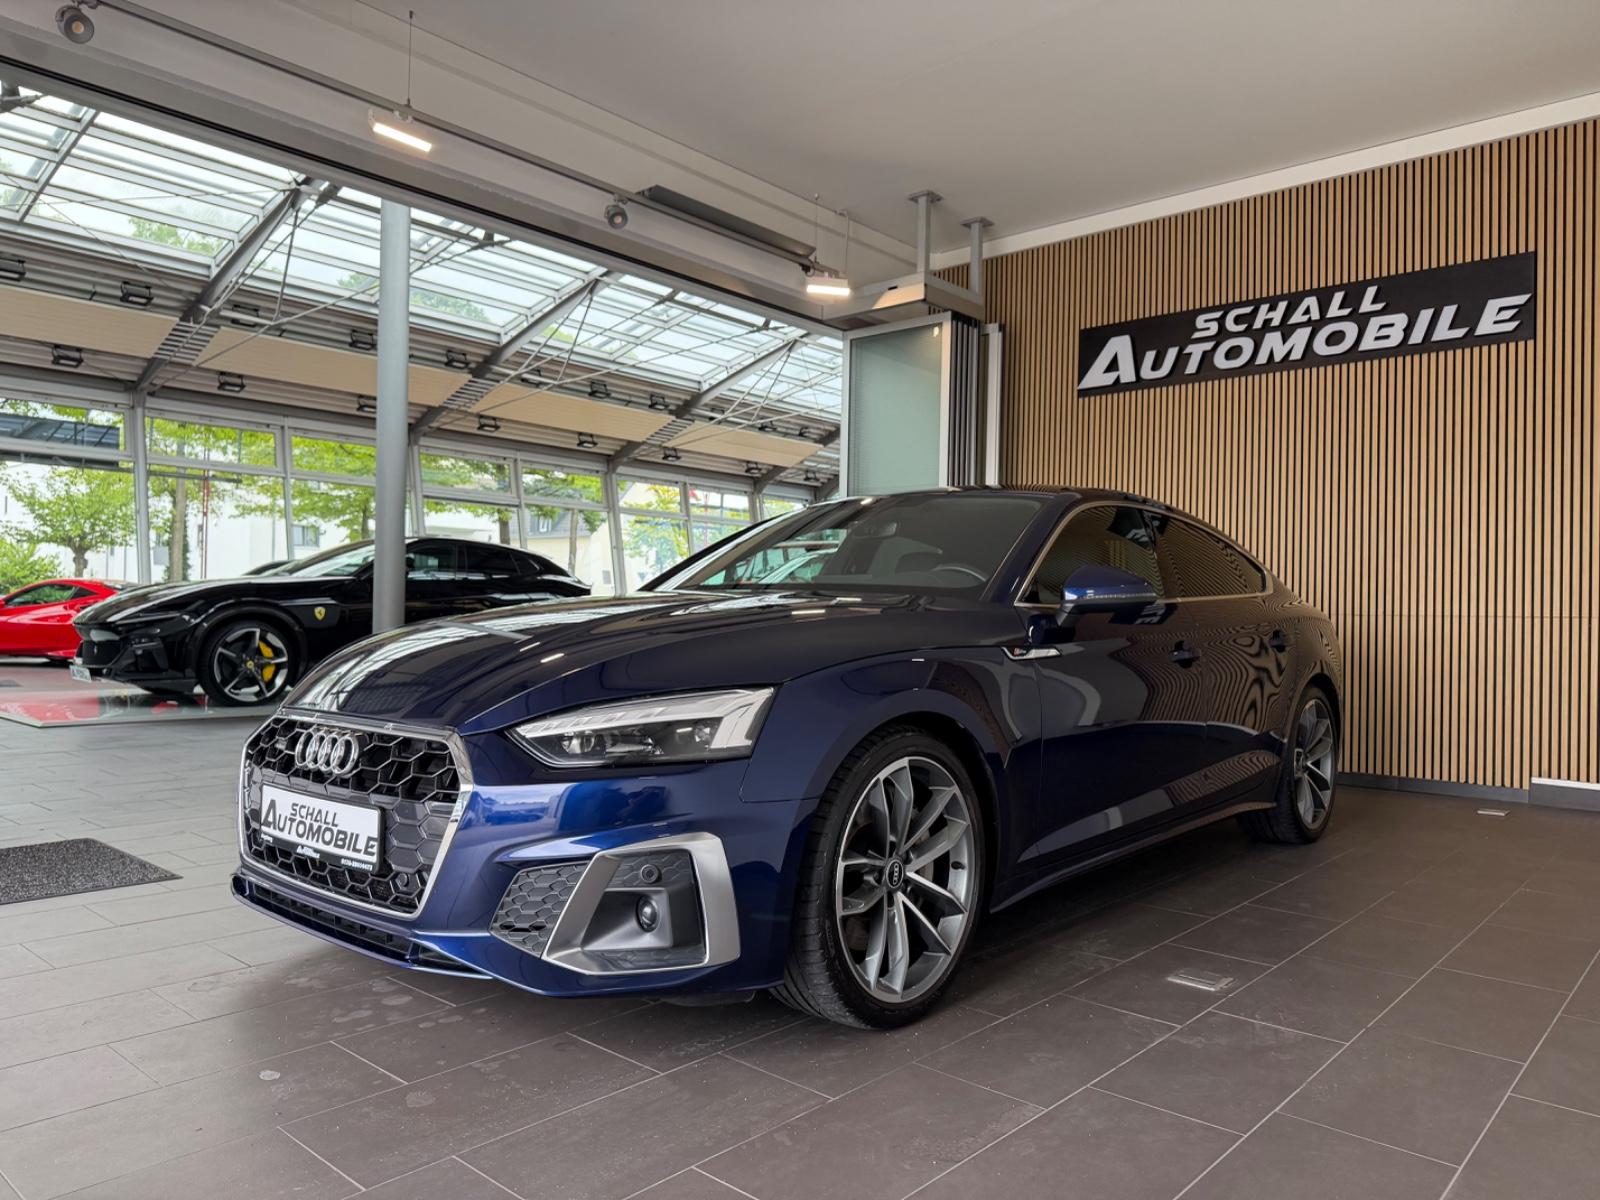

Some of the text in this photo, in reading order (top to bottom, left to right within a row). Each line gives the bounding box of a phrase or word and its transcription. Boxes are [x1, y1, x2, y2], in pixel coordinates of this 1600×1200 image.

[1191, 285, 1388, 339] SCHALL
[1077, 293, 1533, 390] AUTOMOBILE
[261, 798, 378, 857] AUTOMOBILE
[290, 802, 339, 827] SCHALL
